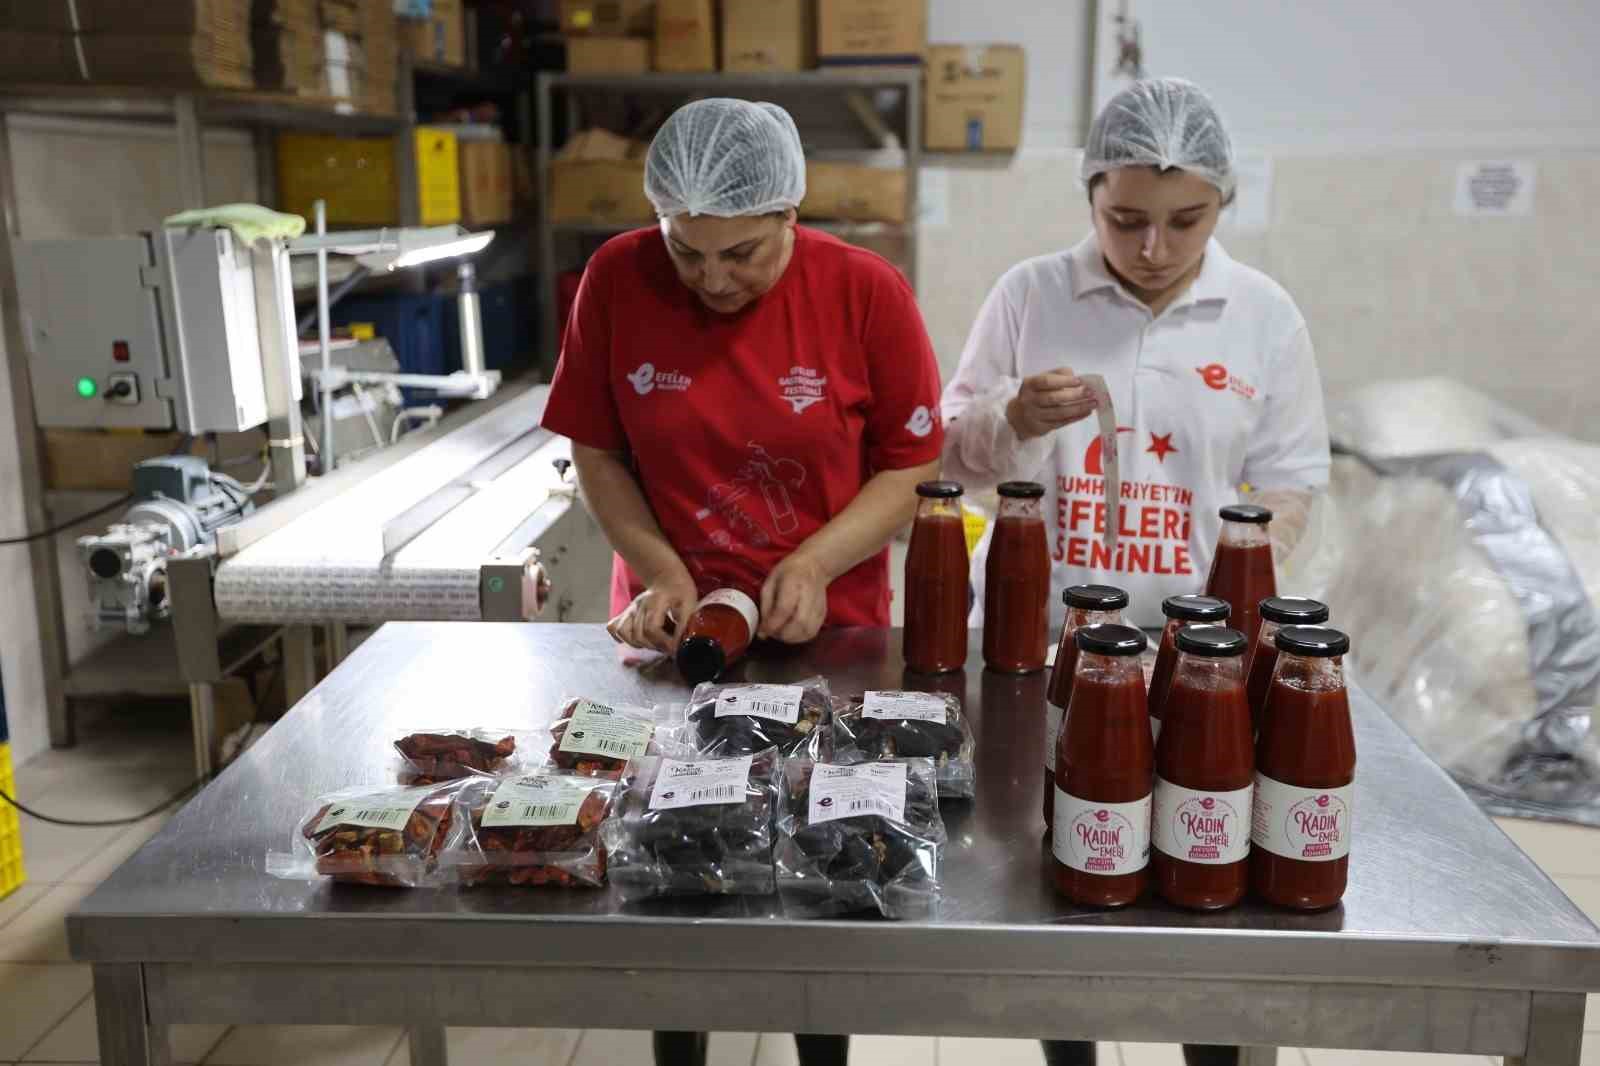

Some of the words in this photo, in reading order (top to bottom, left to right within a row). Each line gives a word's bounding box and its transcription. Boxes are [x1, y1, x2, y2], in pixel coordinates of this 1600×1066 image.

[1076, 823, 1123, 851] KADIN
[1181, 811, 1229, 839] KADIN
[1294, 809, 1341, 838] KADIN
